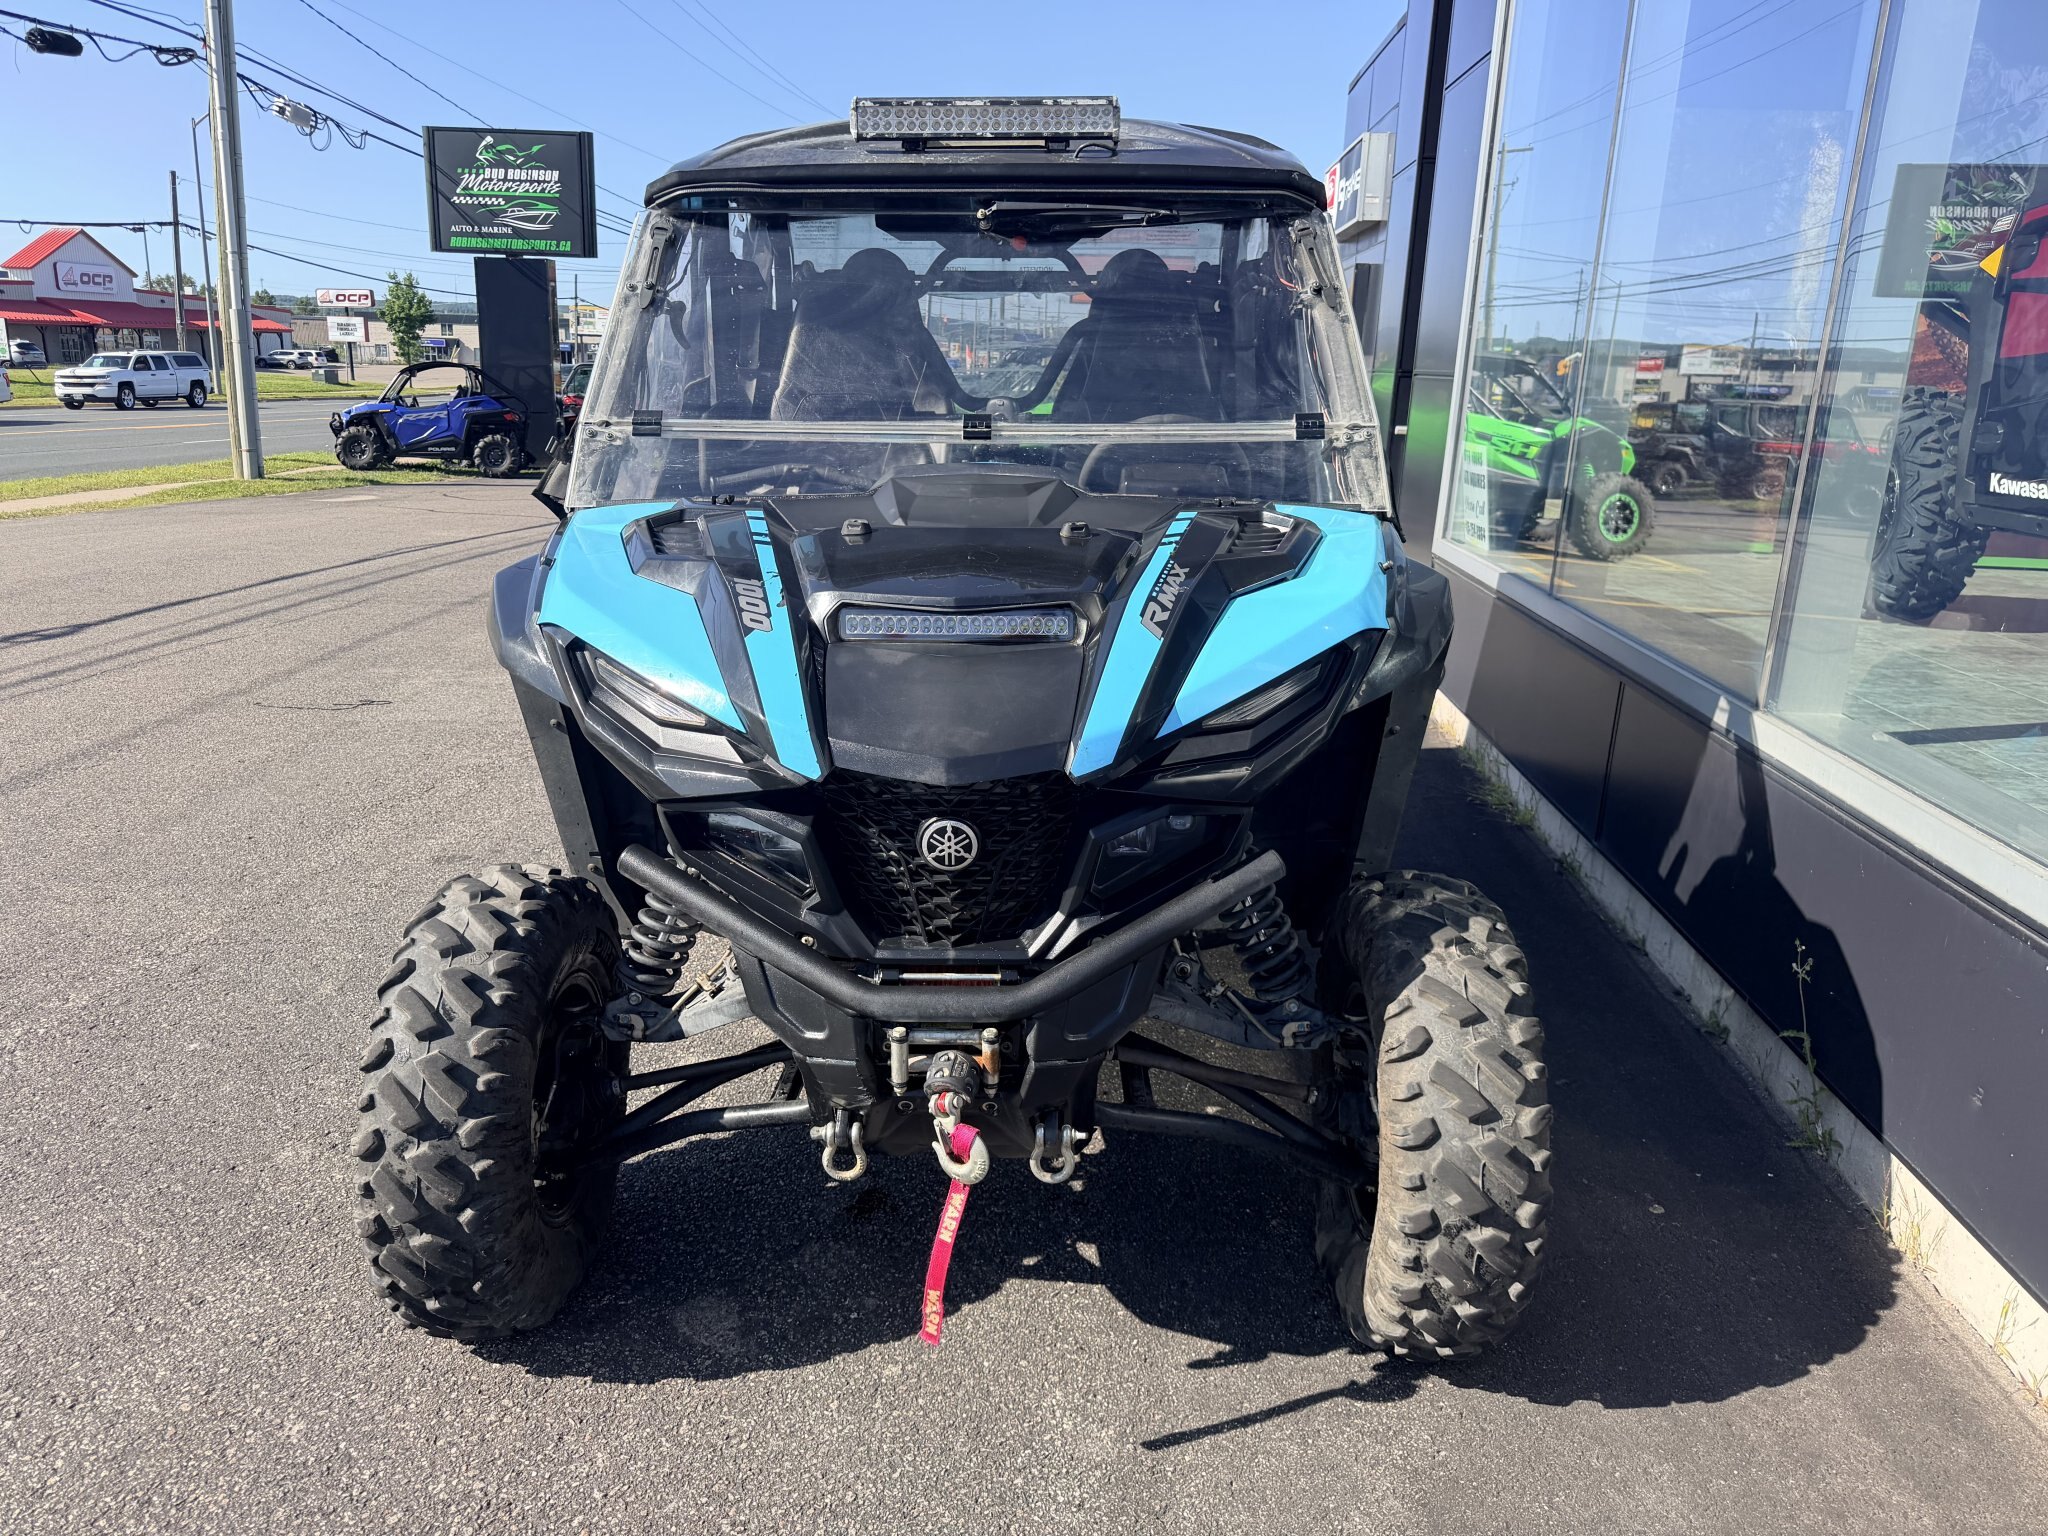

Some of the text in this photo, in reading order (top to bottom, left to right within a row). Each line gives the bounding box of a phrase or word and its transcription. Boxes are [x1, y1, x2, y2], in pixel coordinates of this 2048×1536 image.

[456, 173, 563, 196] Motorsports
[484, 167, 560, 182] BUD ROBINSON
[450, 224, 513, 234] AUTO & MARINE
[450, 236, 572, 252] ROBINSONMOTORSPORTS.CA
[80, 272, 114, 286] OCP
[335, 293, 369, 303] OCP
[1989, 472, 2048, 500] Kawasa
[733, 577, 774, 633] 1000
[972, 1158, 988, 1182] WARN
[938, 1191, 966, 1244] WARN
[924, 1288, 942, 1337] WARN
